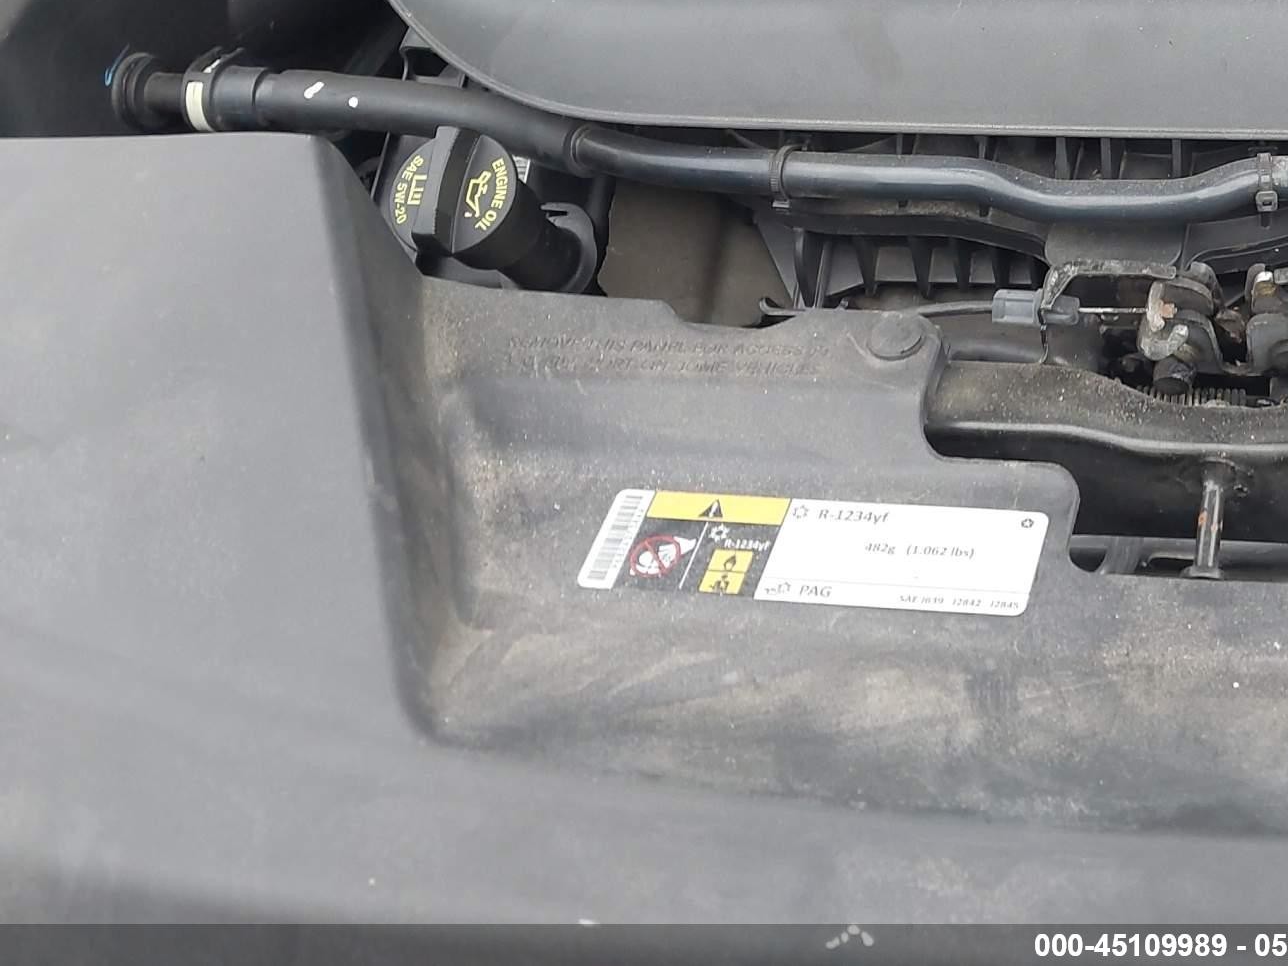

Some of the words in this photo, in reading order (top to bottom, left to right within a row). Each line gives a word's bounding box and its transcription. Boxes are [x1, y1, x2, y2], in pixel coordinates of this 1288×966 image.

[402, 155, 424, 181] SAE
[491, 158, 508, 208] ENGINE
[394, 182, 408, 224] 5W-20
[475, 210, 497, 230] OIL
[818, 509, 889, 524] R-1234yf
[724, 538, 770, 551] R-1234yf
[864, 542, 896, 556] 482g
[906, 544, 948, 557] (1.062
[950, 546, 975, 559] lbs)
[799, 584, 833, 598] PAG
